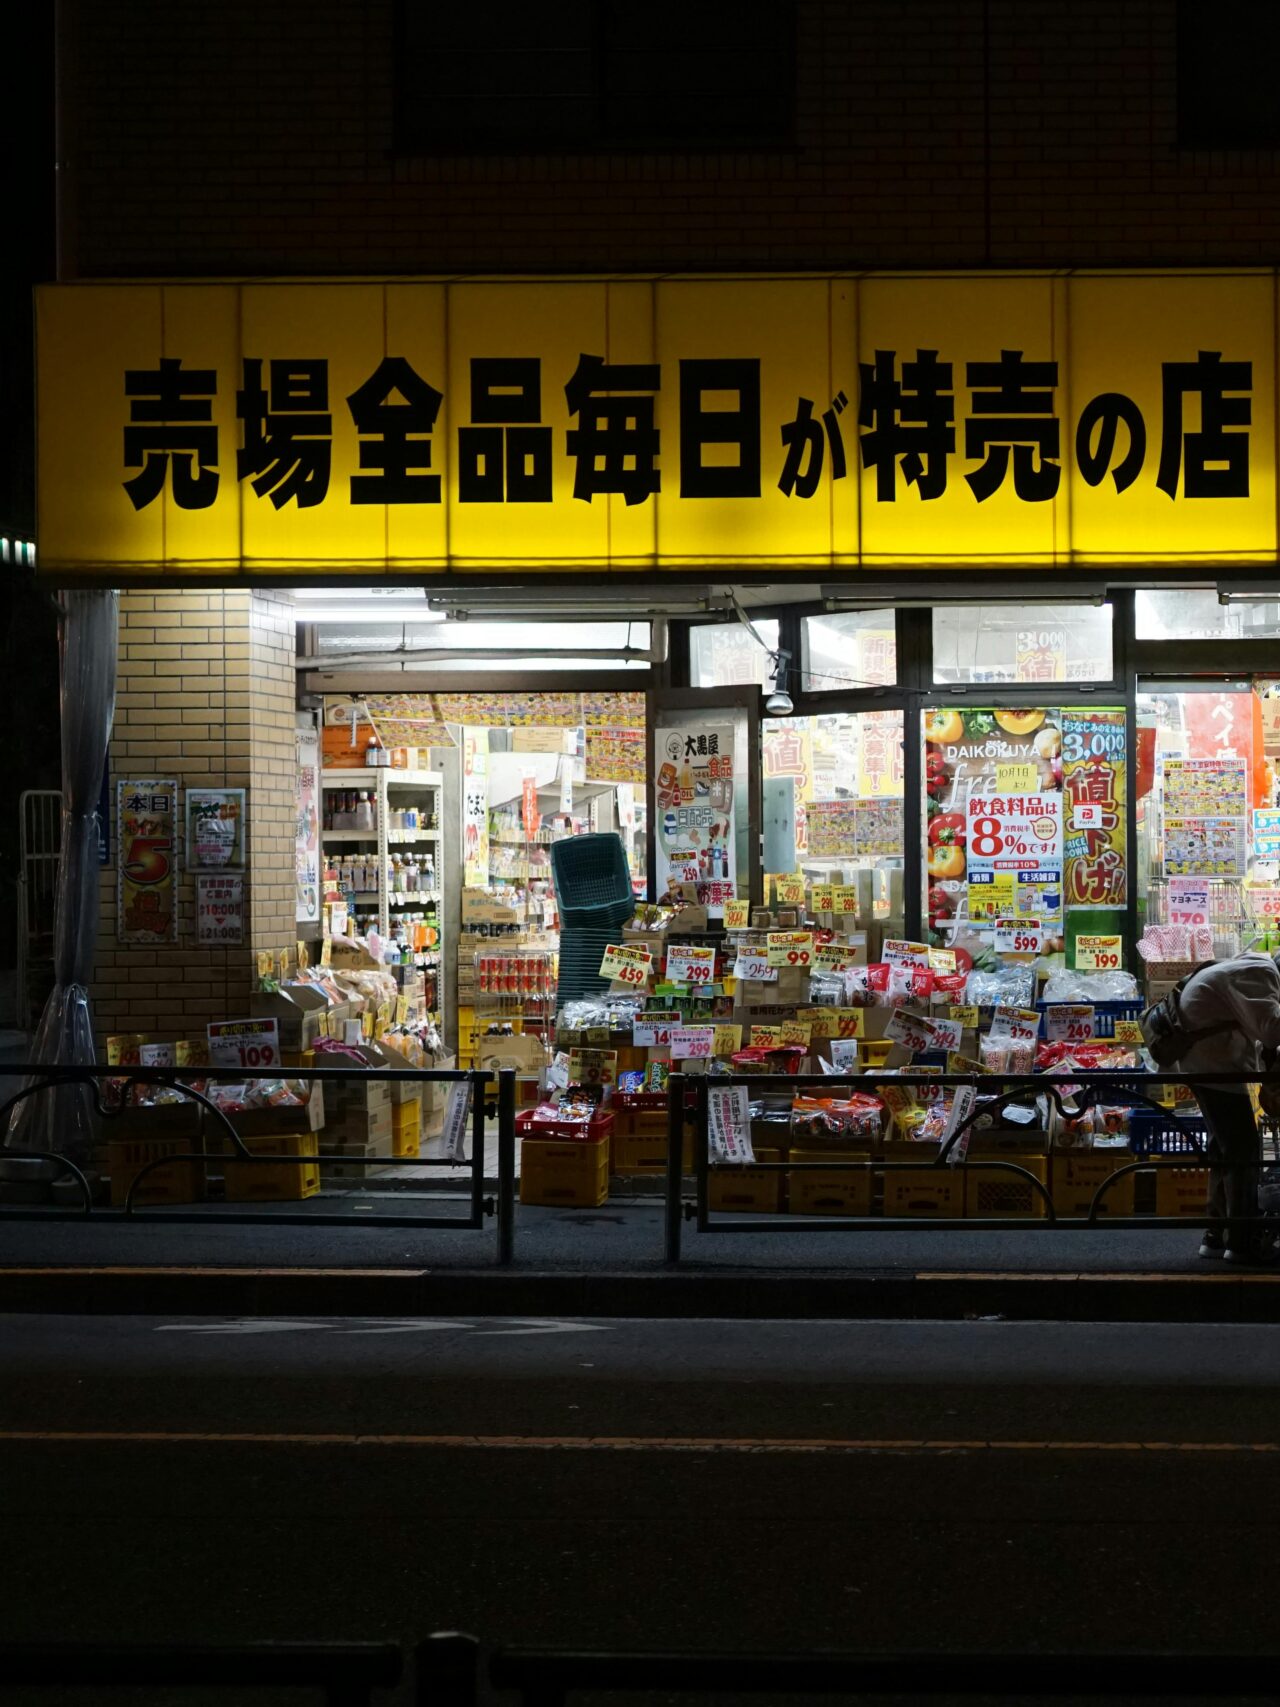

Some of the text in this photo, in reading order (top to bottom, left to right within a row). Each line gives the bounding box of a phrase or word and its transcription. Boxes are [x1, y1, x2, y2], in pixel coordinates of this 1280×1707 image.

[122, 350, 1253, 511] 売場全品毎日が特売の店
[685, 733, 719, 756] 大黒屋
[947, 744, 1041, 758] DAIKOKUYA
[1063, 734, 1125, 762] 3,000
[708, 755, 734, 779] 食品
[681, 789, 693, 799] OIL
[126, 794, 169, 813] 本日
[968, 797, 1058, 817] 飲食料品は
[123, 838, 172, 885] 5
[682, 868, 698, 881] 259
[698, 881, 735, 904] お菓子
[1170, 896, 1207, 904] マヨネーズ
[206, 903, 236, 915] 10:00
[206, 928, 236, 939] 21:00
[1014, 936, 1038, 951] 599
[786, 951, 810, 965] 99
[1093, 953, 1119, 968] 199
[618, 966, 645, 983] 459
[686, 965, 710, 980] 299
[749, 963, 774, 979] 259
[653, 1029, 673, 1045] 14
[1067, 1023, 1092, 1038] 249
[688, 1042, 711, 1057] 299
[902, 1032, 927, 1053] 299
[238, 1045, 274, 1067] 109
[587, 1068, 613, 1083] 95
